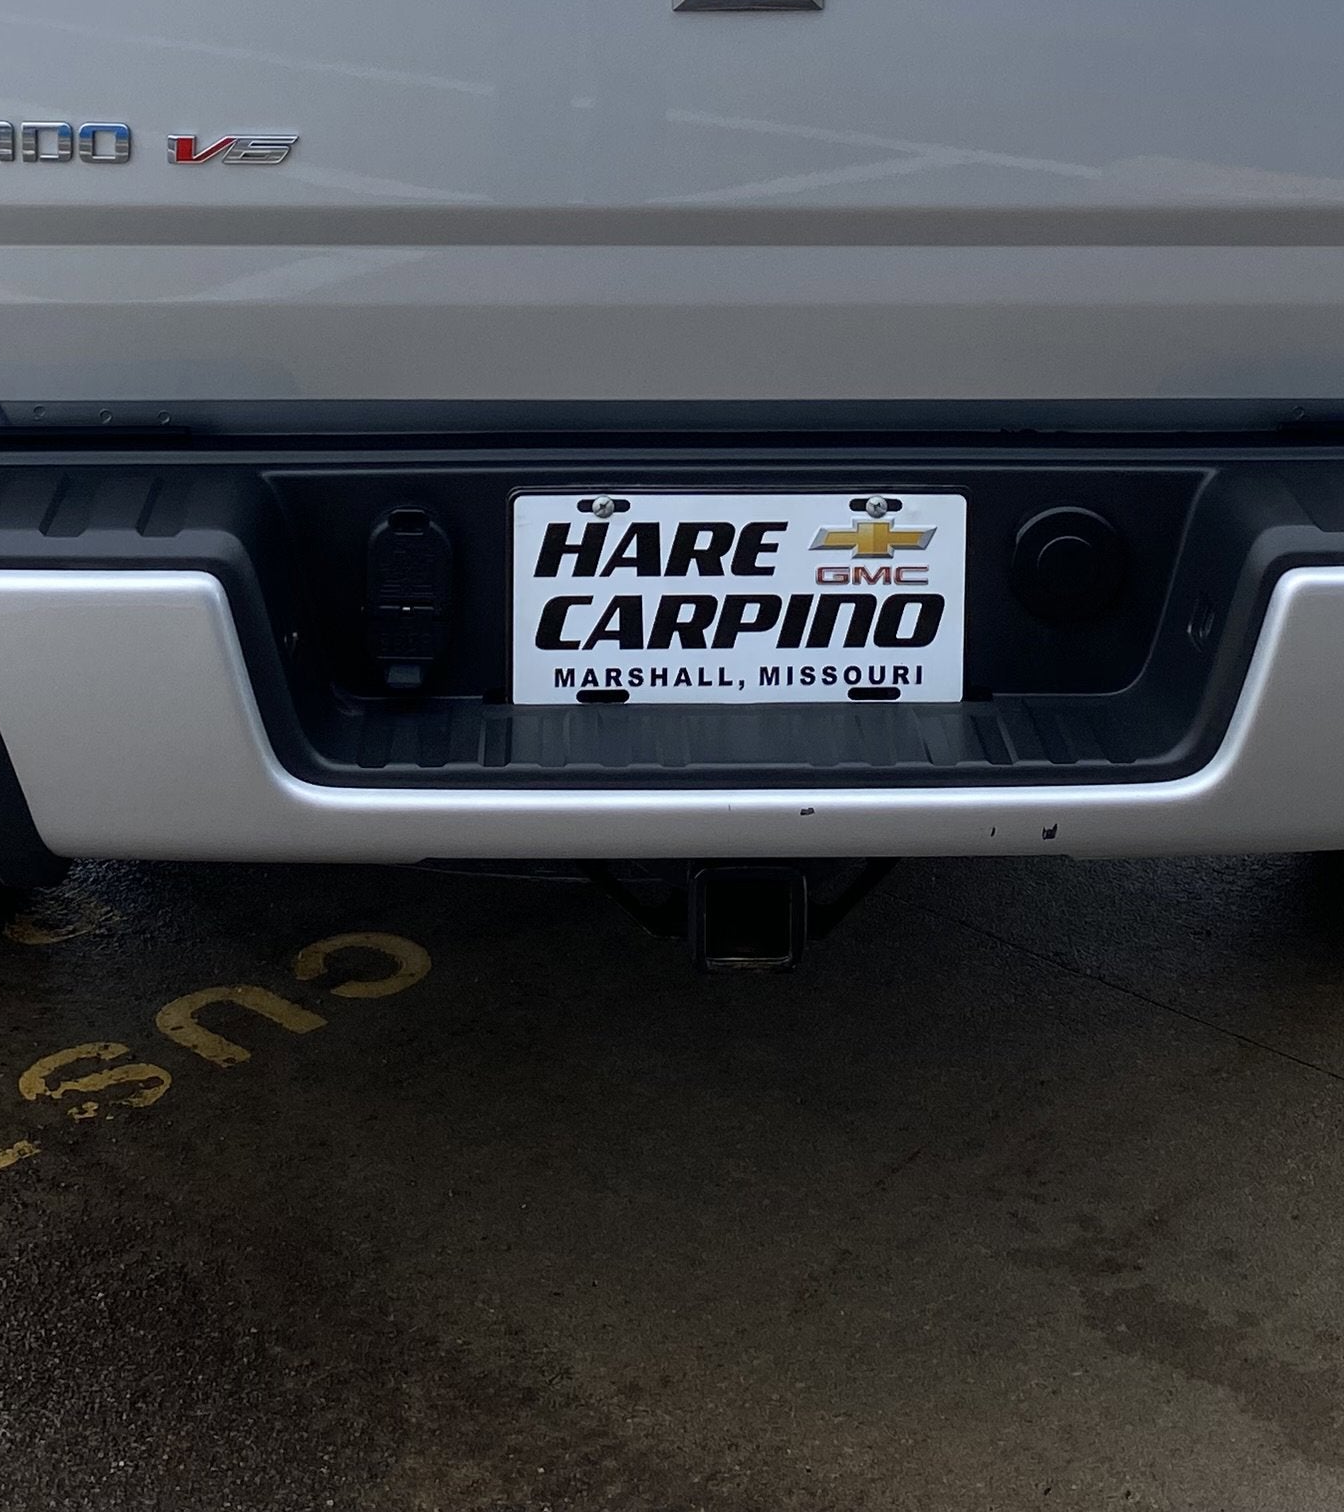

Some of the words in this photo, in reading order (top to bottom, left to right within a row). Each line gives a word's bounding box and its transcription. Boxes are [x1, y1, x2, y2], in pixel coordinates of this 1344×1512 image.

[167, 134, 300, 165] V6
[533, 521, 788, 577] HARE
[815, 565, 930, 586] GMC
[535, 593, 946, 651] CARPINO
[554, 667, 746, 690] MARSHALL,
[759, 665, 924, 687] MISSOURI
